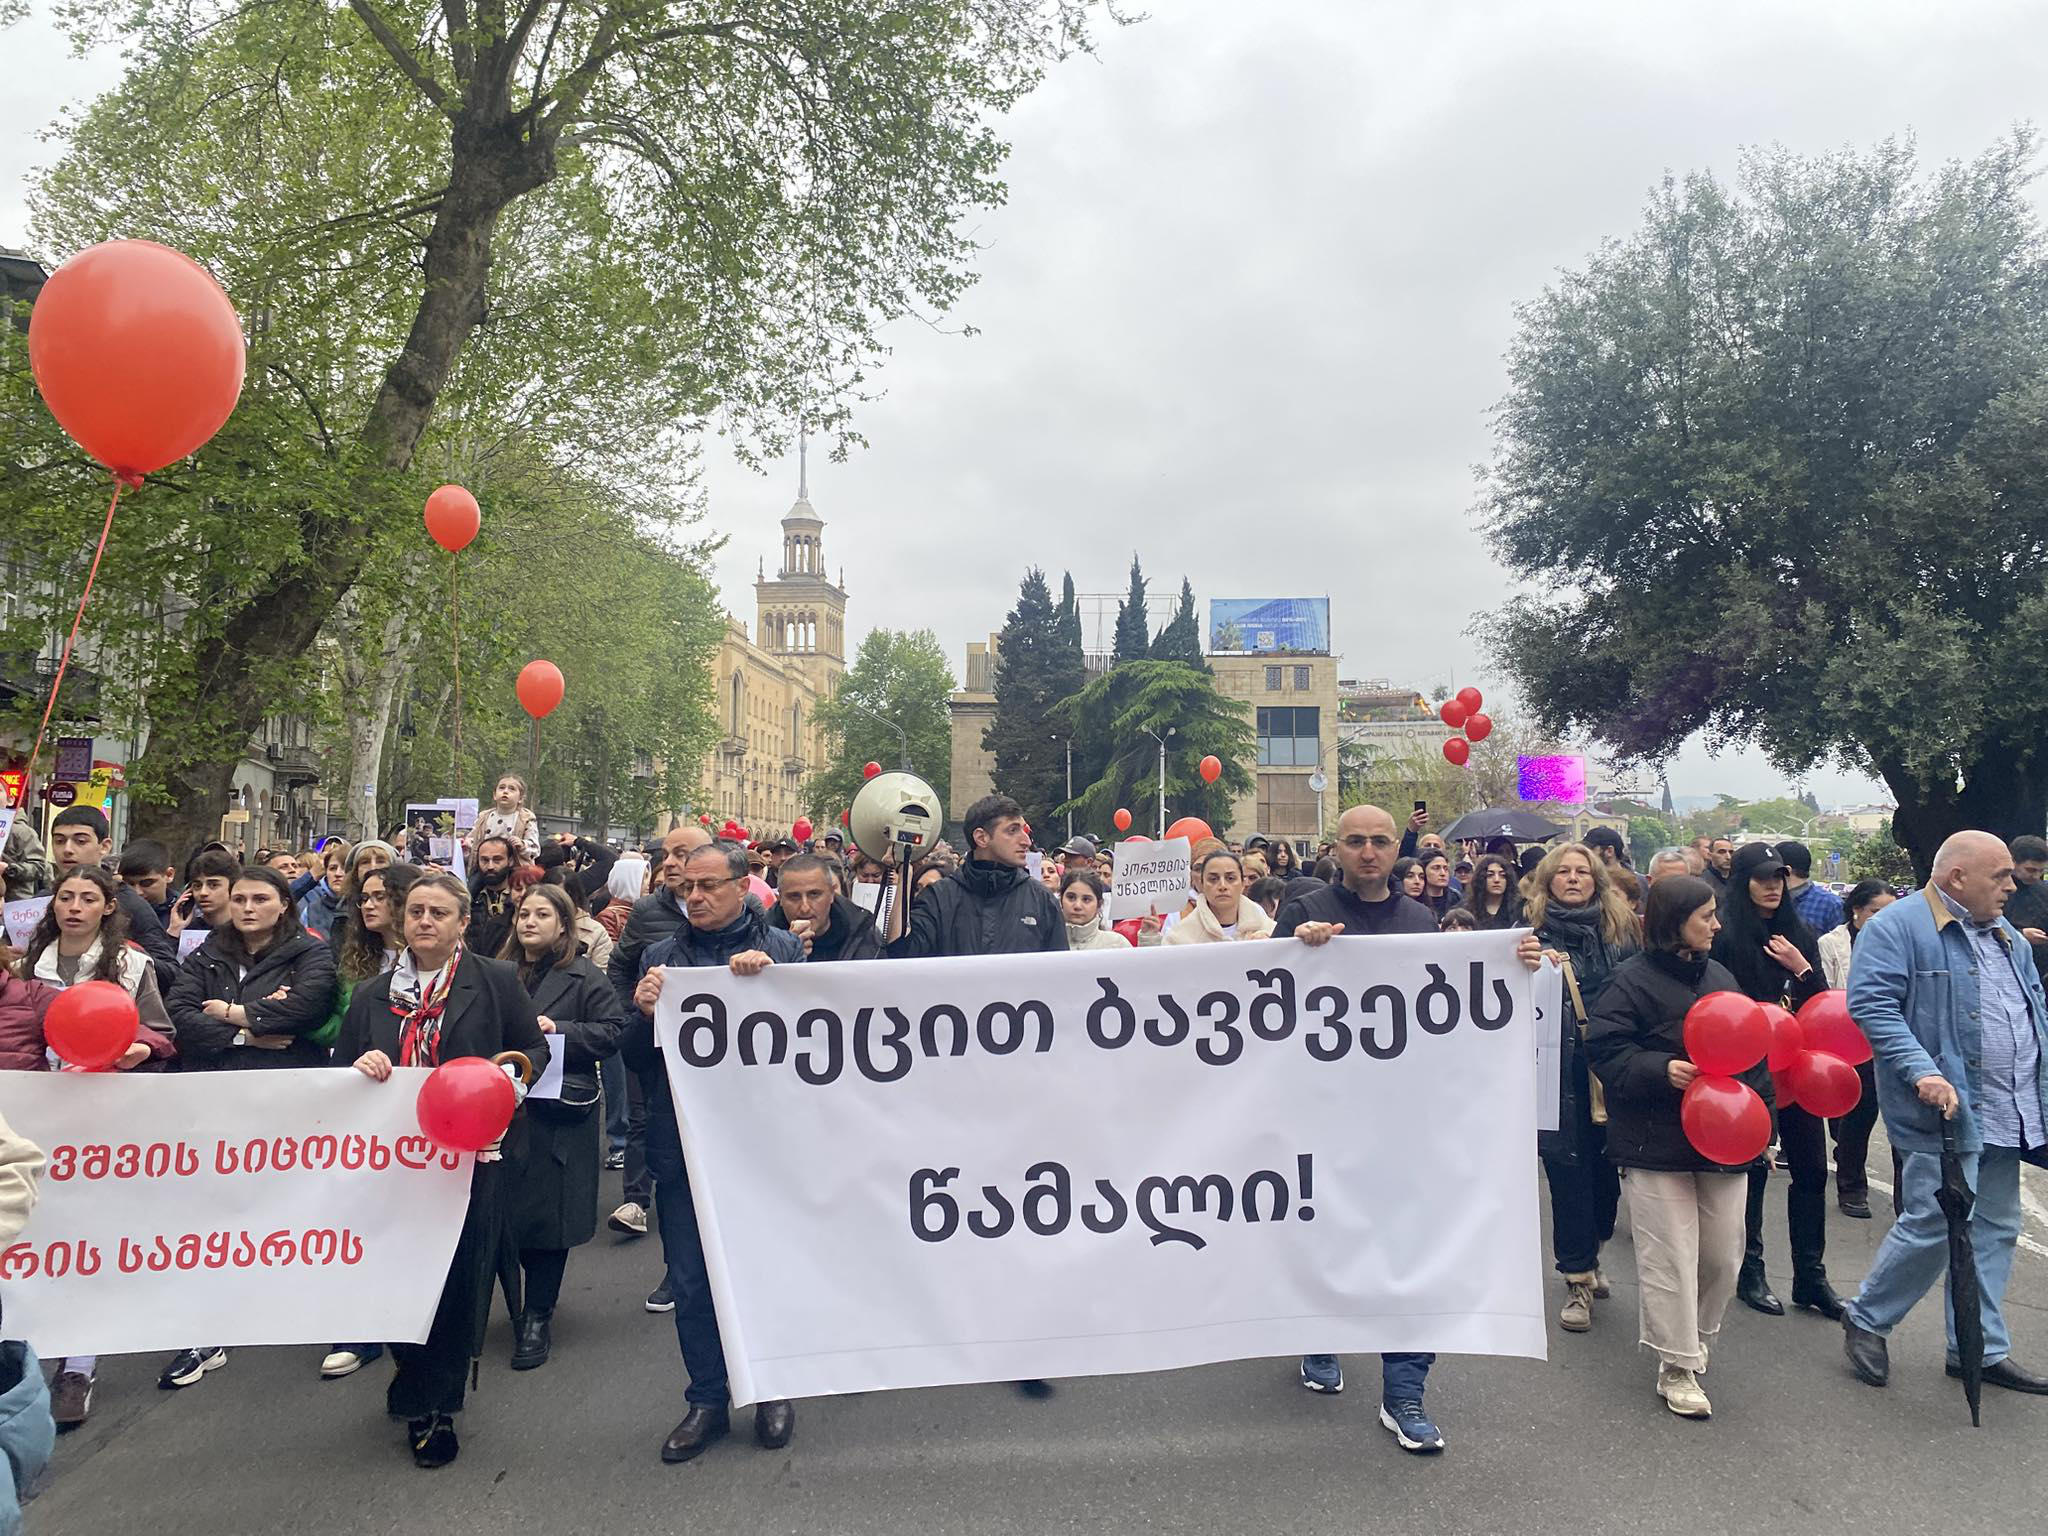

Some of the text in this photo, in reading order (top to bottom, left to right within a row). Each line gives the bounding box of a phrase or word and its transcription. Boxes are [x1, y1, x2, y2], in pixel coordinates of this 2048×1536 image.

[678, 961, 1515, 1086] მიეცით ბავშვებს
[50, 1141, 200, 1182] ვშვის
[909, 1153, 1315, 1251] წამალი!
[117, 1227, 364, 1274] სამყაროს
